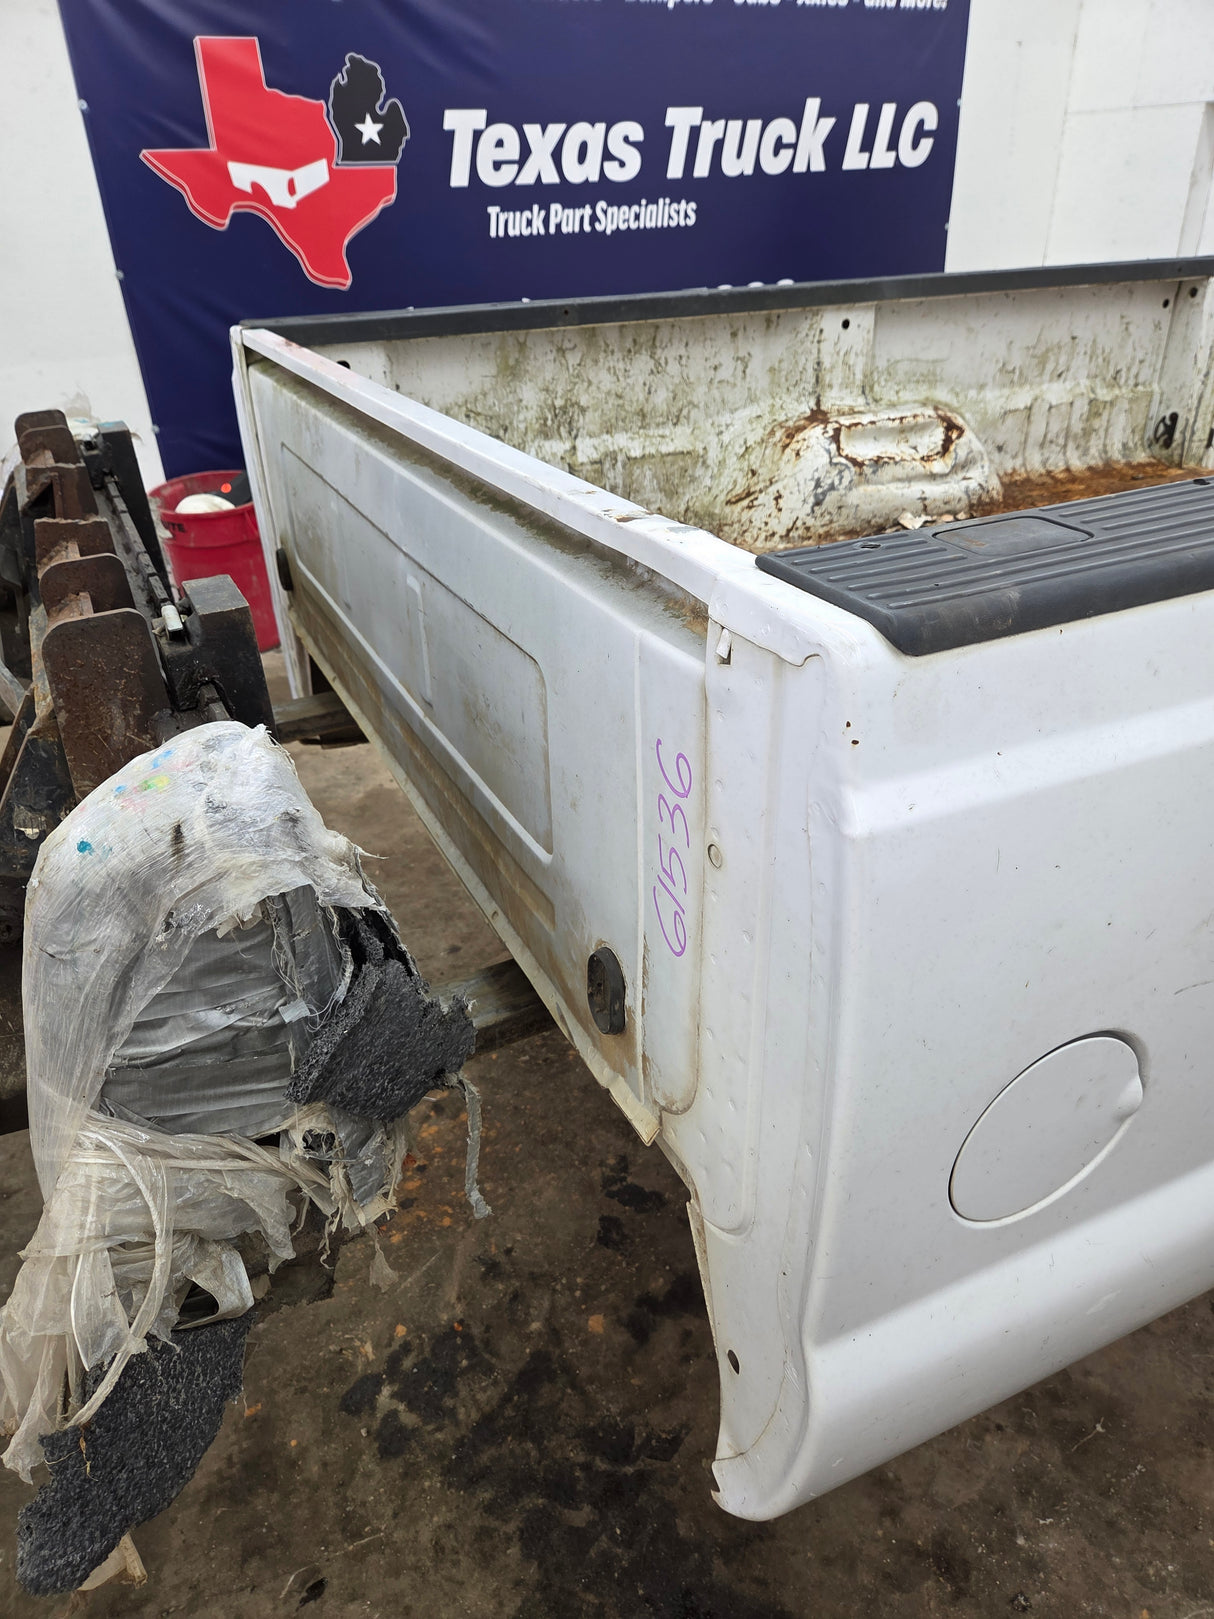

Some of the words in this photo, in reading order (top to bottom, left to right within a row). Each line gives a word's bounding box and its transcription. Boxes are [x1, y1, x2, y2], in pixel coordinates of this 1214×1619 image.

[442, 108, 645, 188] Texas
[664, 97, 837, 180] Truck
[841, 100, 939, 171] LLC
[486, 203, 546, 238] Truck
[548, 202, 593, 235] Part
[594, 196, 698, 236] Specialists
[652, 738, 693, 957] 61536
